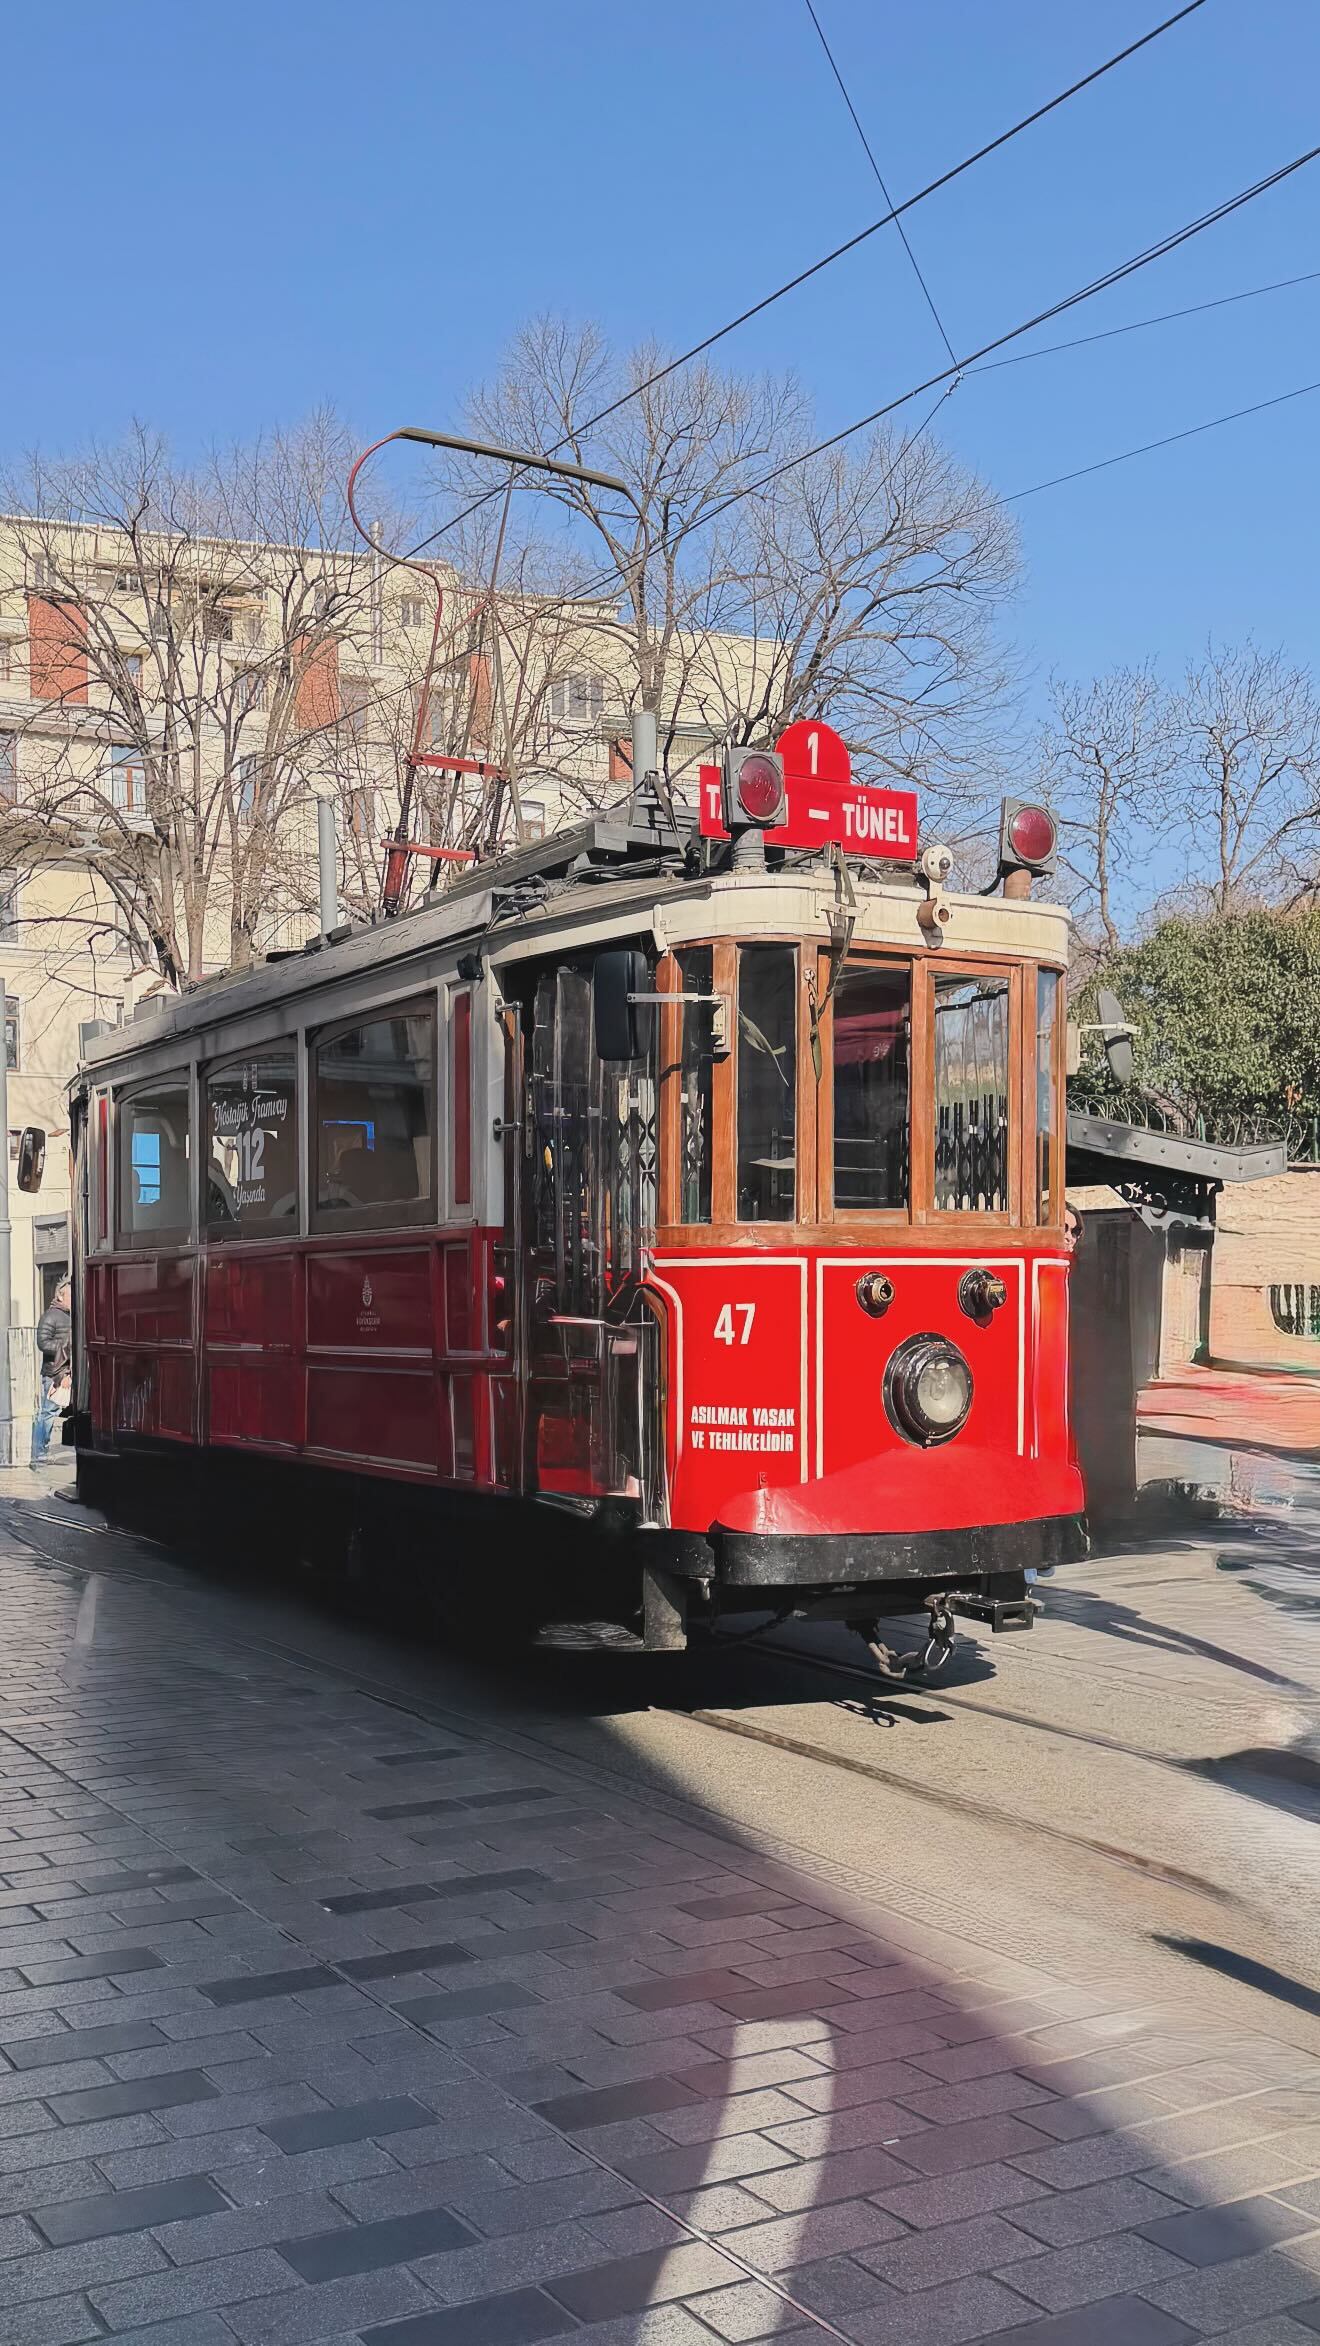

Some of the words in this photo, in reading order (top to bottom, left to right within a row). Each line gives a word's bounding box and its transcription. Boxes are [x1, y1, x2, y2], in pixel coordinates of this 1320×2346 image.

[807, 732, 819, 775] 1
[842, 795, 910, 844] TÜNEL
[236, 1127, 265, 1182] 112
[713, 1303, 756, 1345] 47
[691, 1406, 748, 1426] ASILMAK
[752, 1407, 796, 1427] YASAK
[692, 1430, 705, 1449] VE
[708, 1429, 794, 1452] TEHLİKELİDİR
